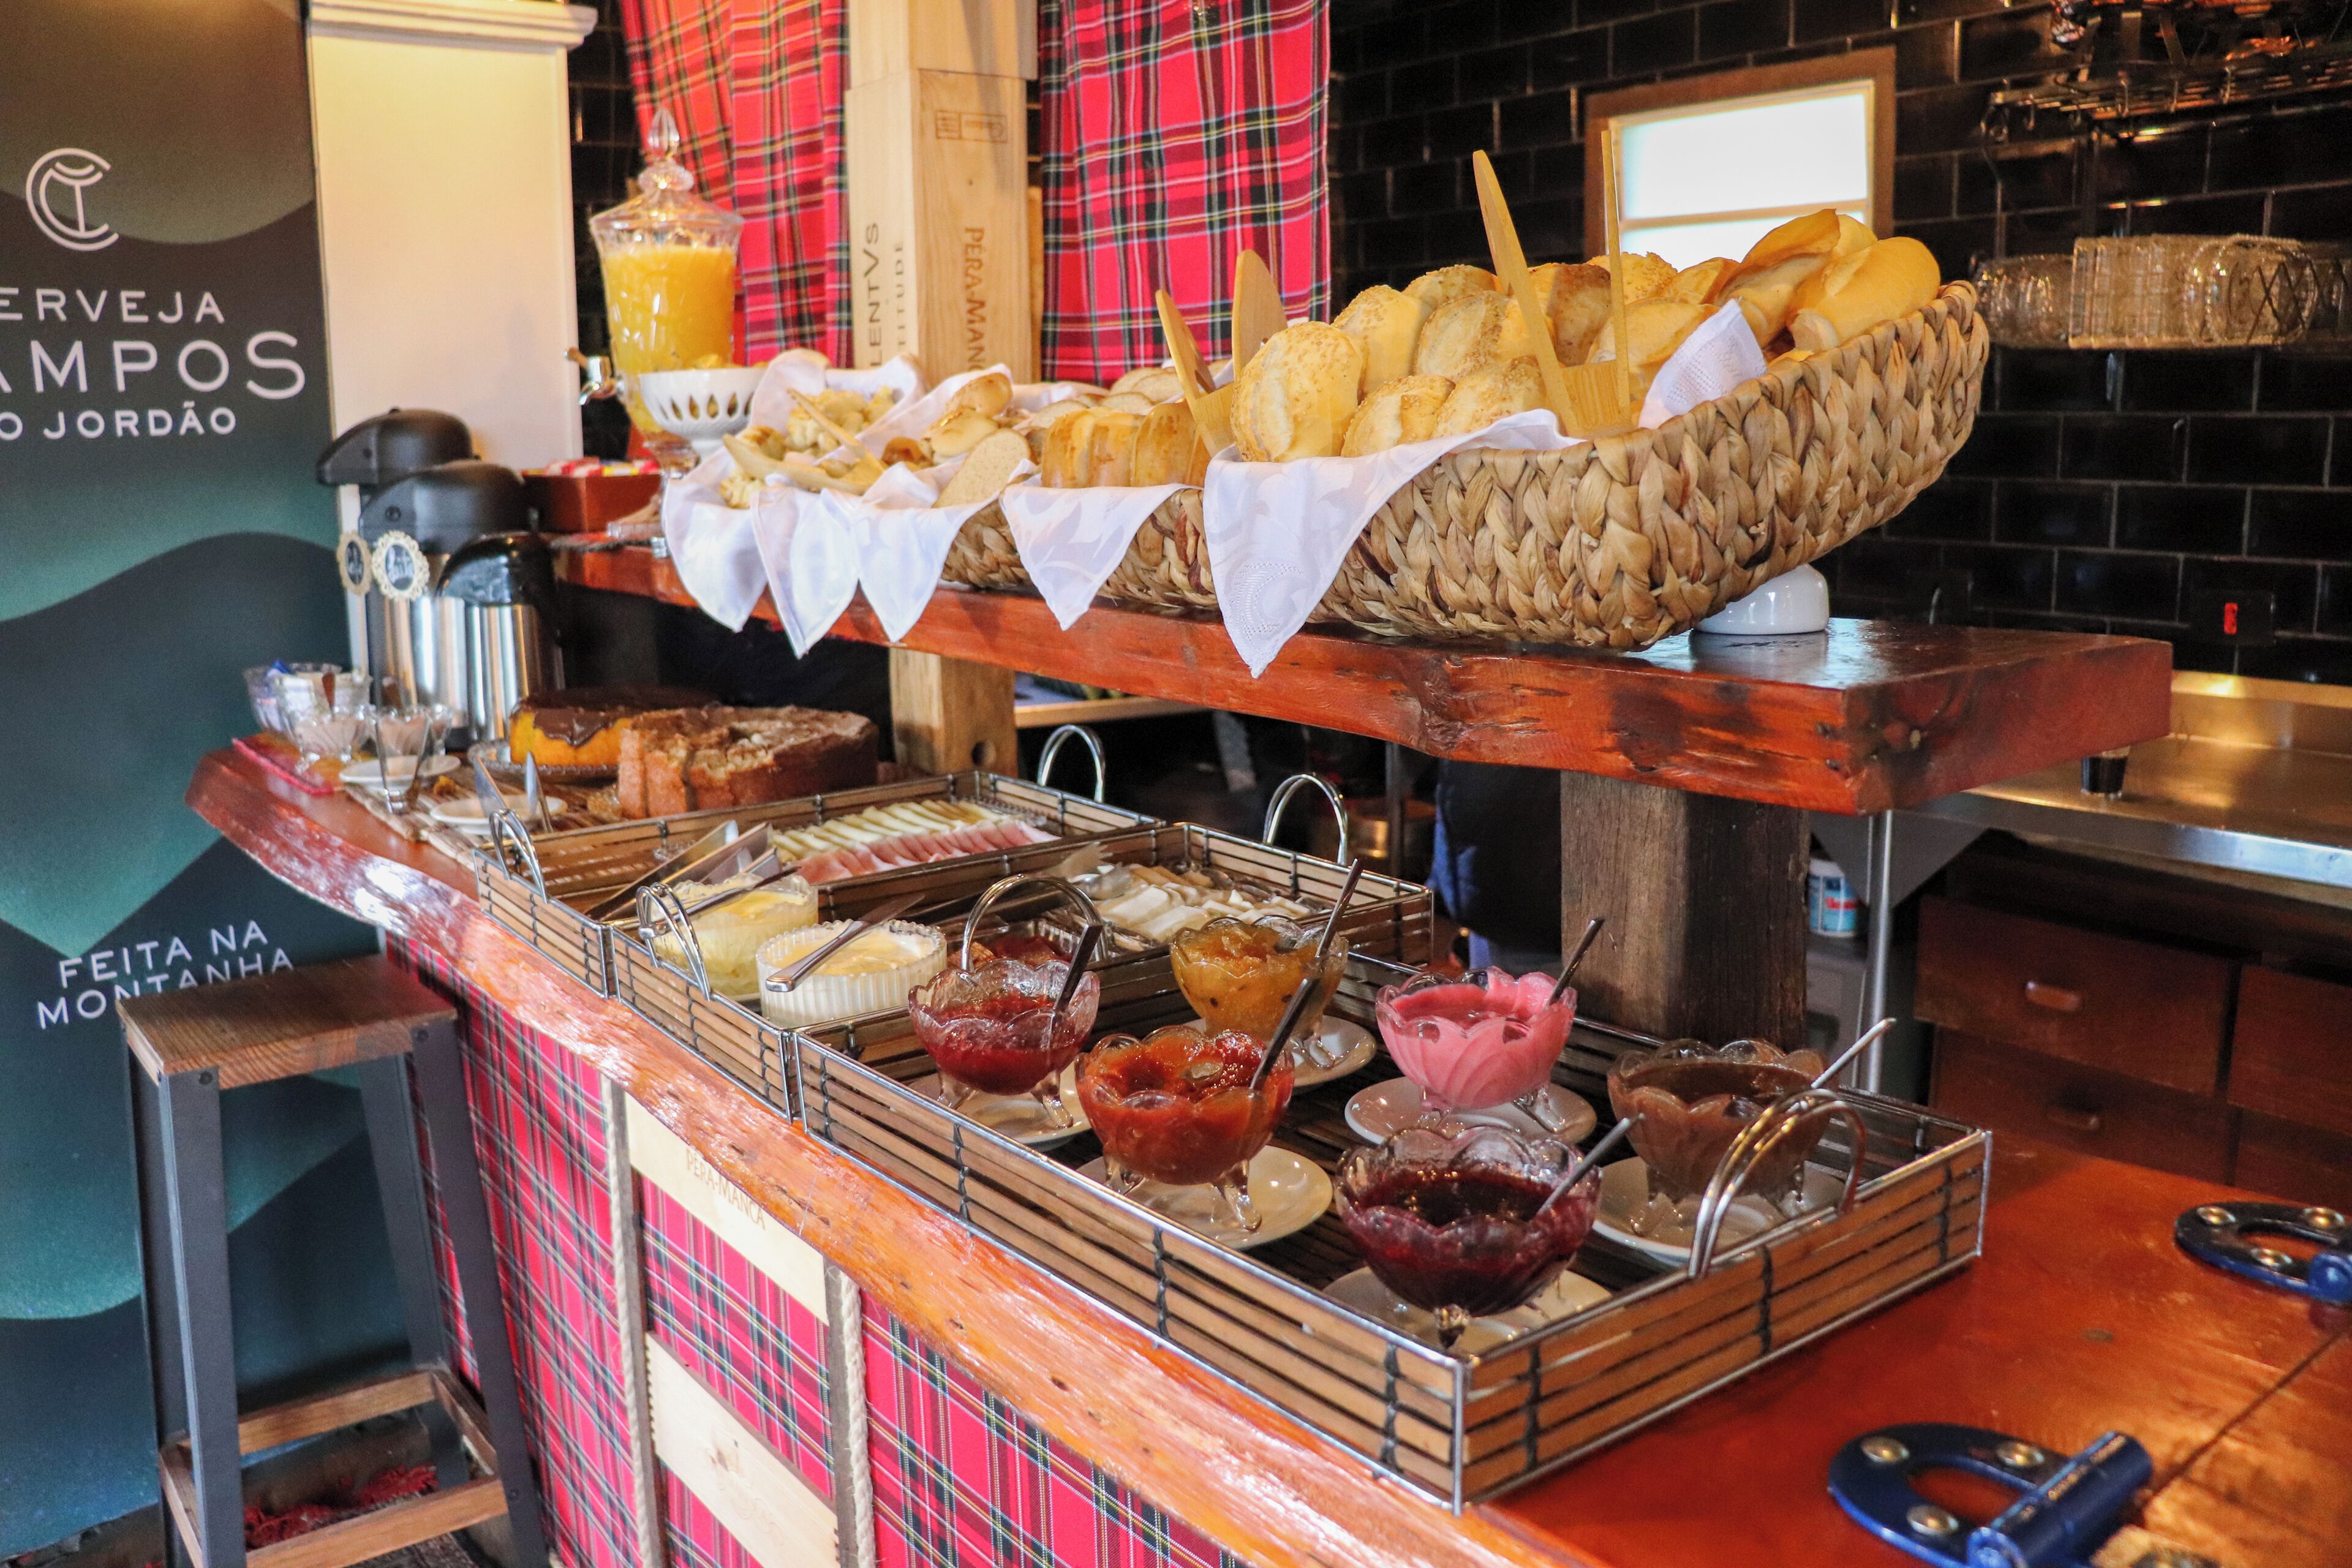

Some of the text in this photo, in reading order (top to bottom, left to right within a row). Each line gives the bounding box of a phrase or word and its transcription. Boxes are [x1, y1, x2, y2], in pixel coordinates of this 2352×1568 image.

[43, 401, 236, 440] JORDÃO
[59, 920, 268, 989] FEITA NA
